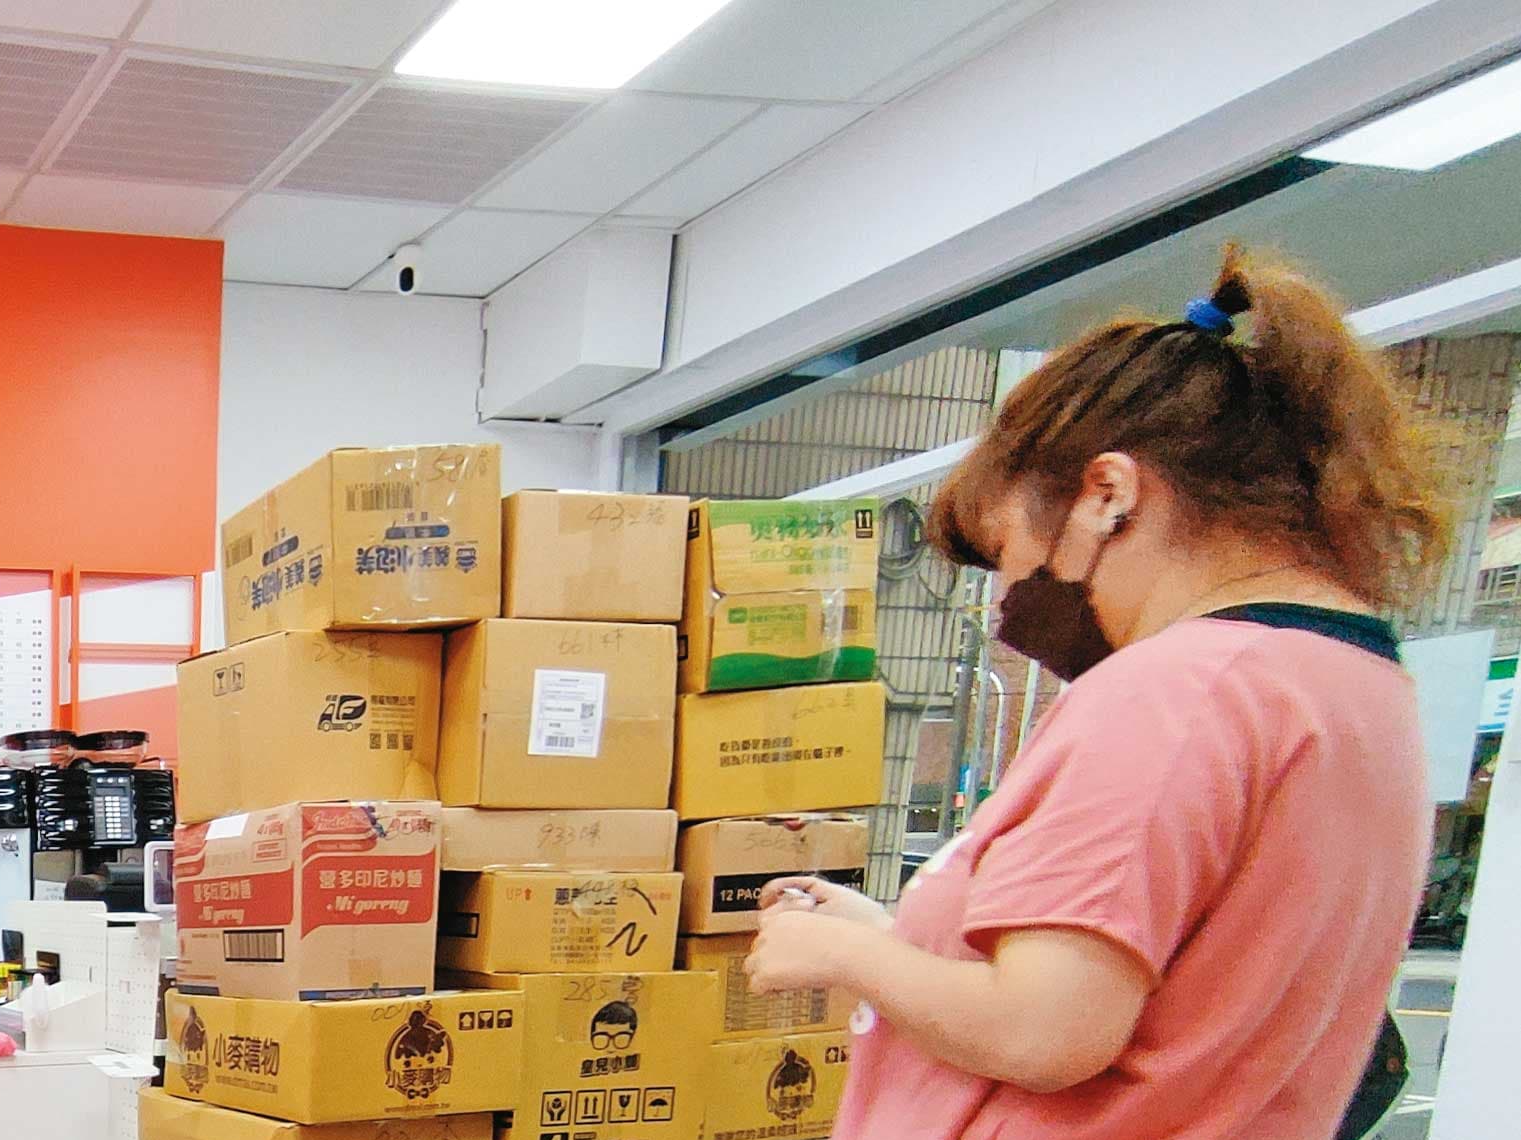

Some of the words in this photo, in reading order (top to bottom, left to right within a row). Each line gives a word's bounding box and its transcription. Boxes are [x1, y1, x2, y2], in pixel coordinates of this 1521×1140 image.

[720, 889, 733, 902] 12
[212, 1032, 280, 1077] 小麥購物
